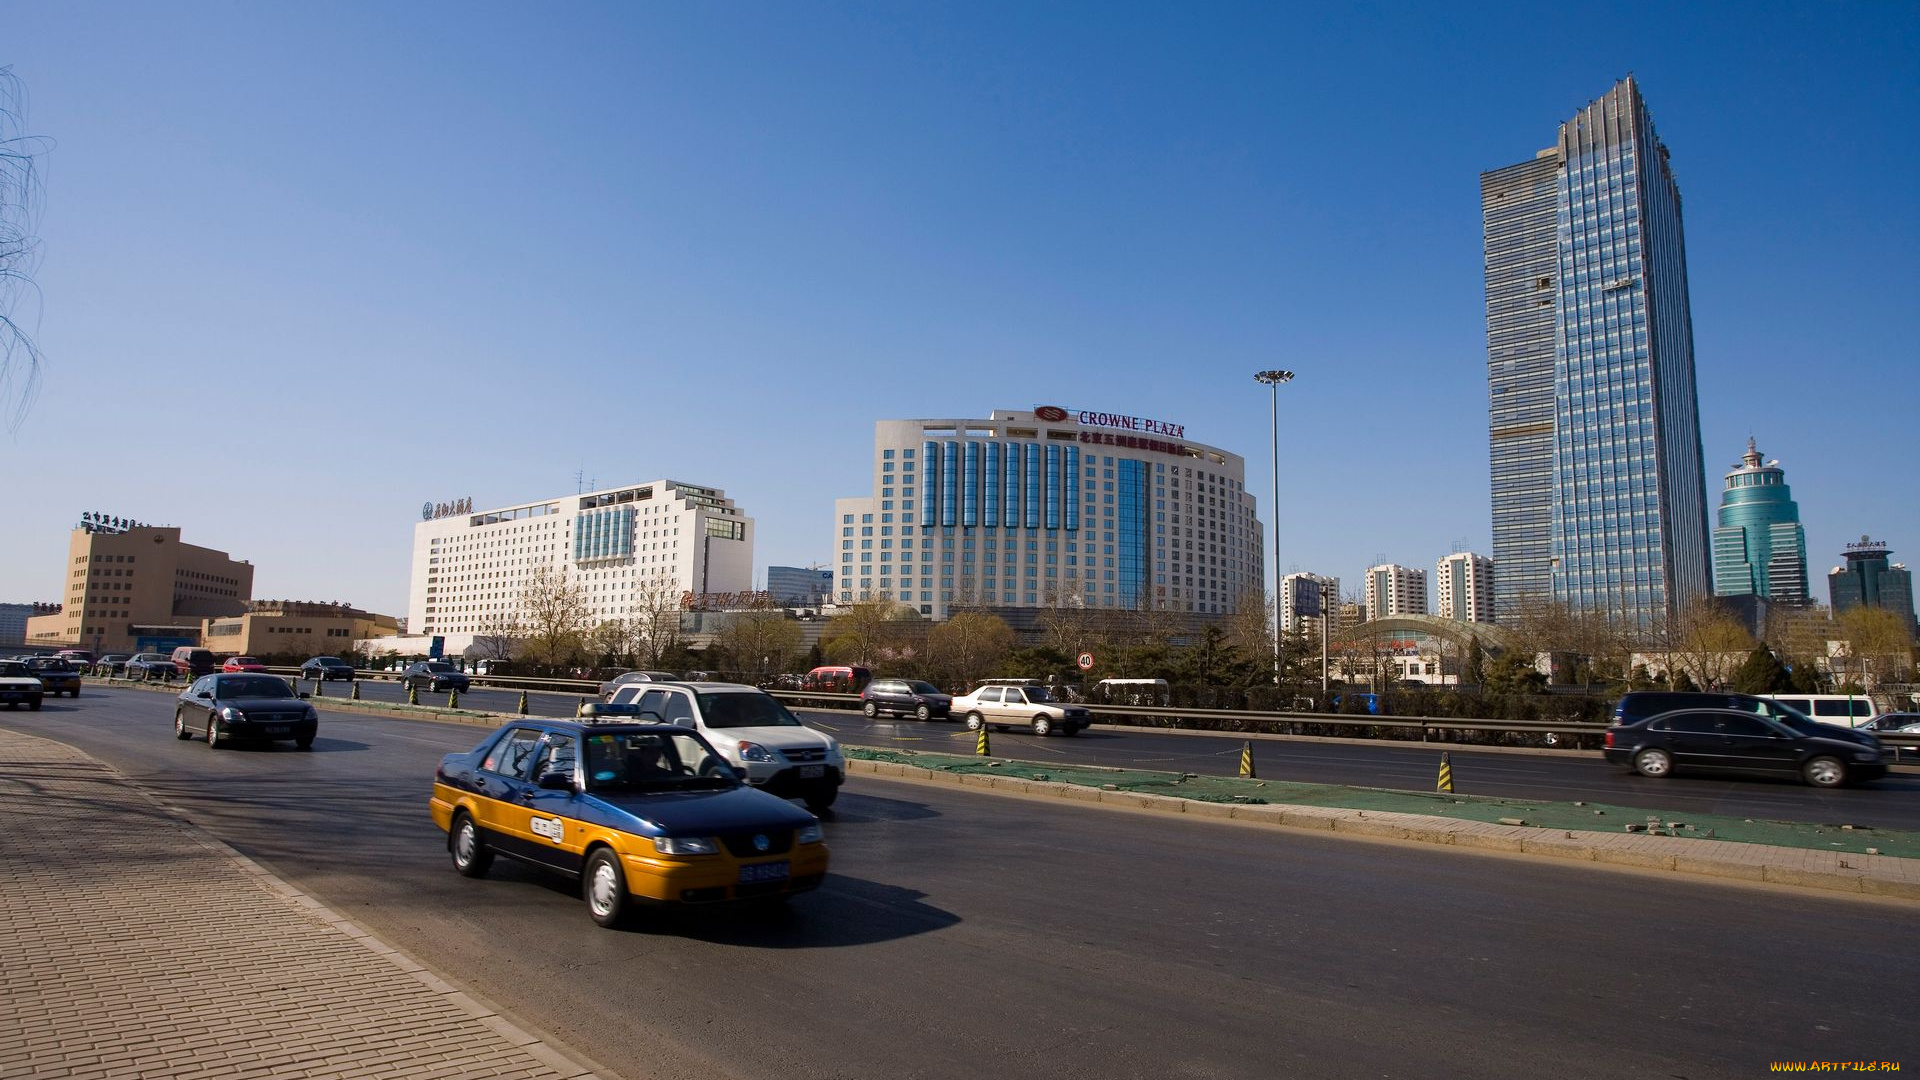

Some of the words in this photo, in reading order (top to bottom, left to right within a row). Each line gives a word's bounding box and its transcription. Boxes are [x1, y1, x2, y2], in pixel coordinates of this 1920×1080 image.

[1080, 411, 1139, 430] CROWNE
[1145, 419, 1184, 439] PLAZA
[1081, 656, 1091, 666] 40
